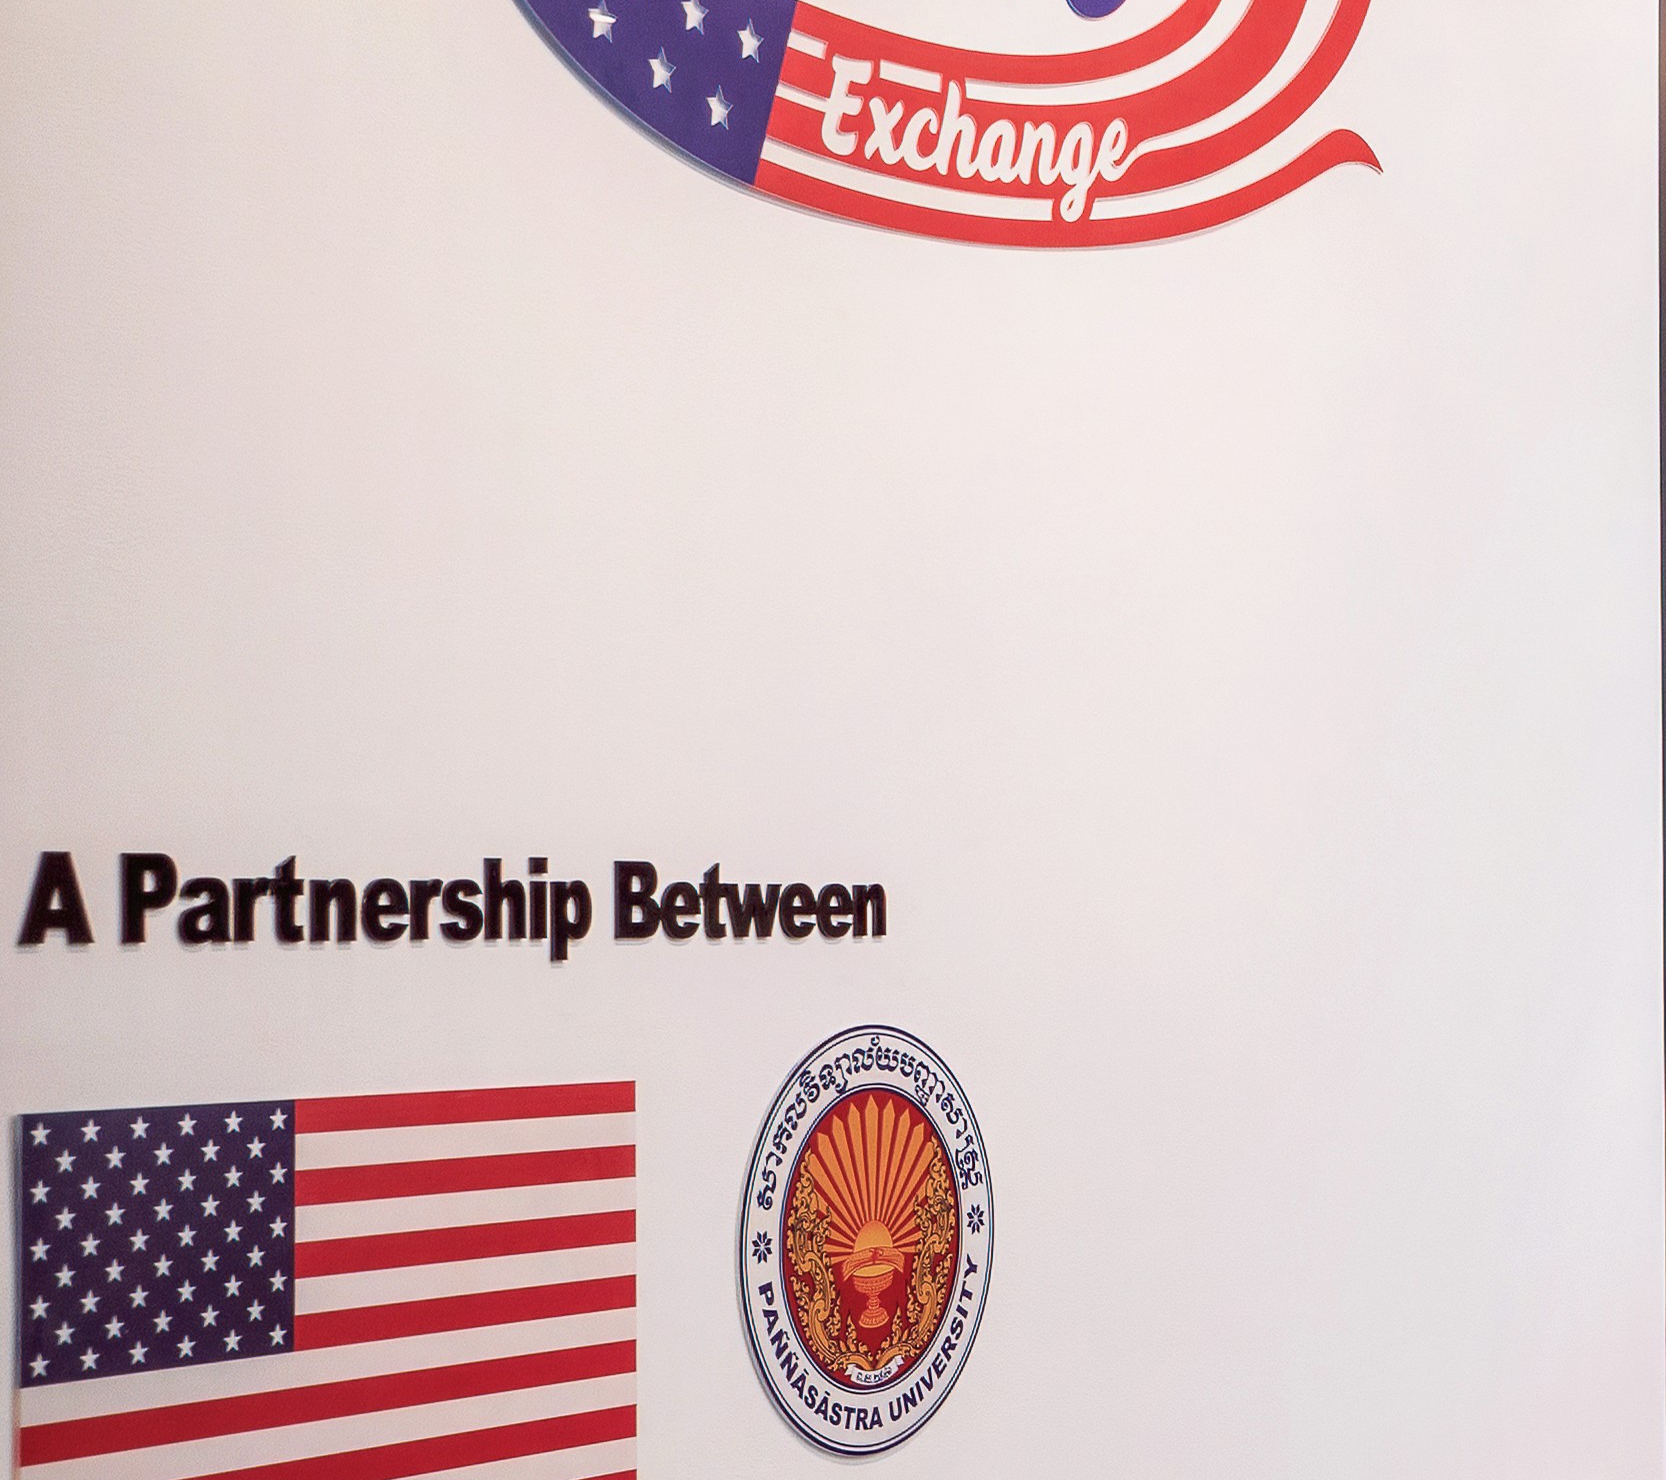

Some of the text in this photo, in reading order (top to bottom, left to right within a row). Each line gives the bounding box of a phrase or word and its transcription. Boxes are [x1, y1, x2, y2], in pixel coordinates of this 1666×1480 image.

[818, 57, 1136, 223] Exchange
[18, 851, 887, 963] A Partnership Between
[888, 1252, 980, 1421] UNIVERSITY
